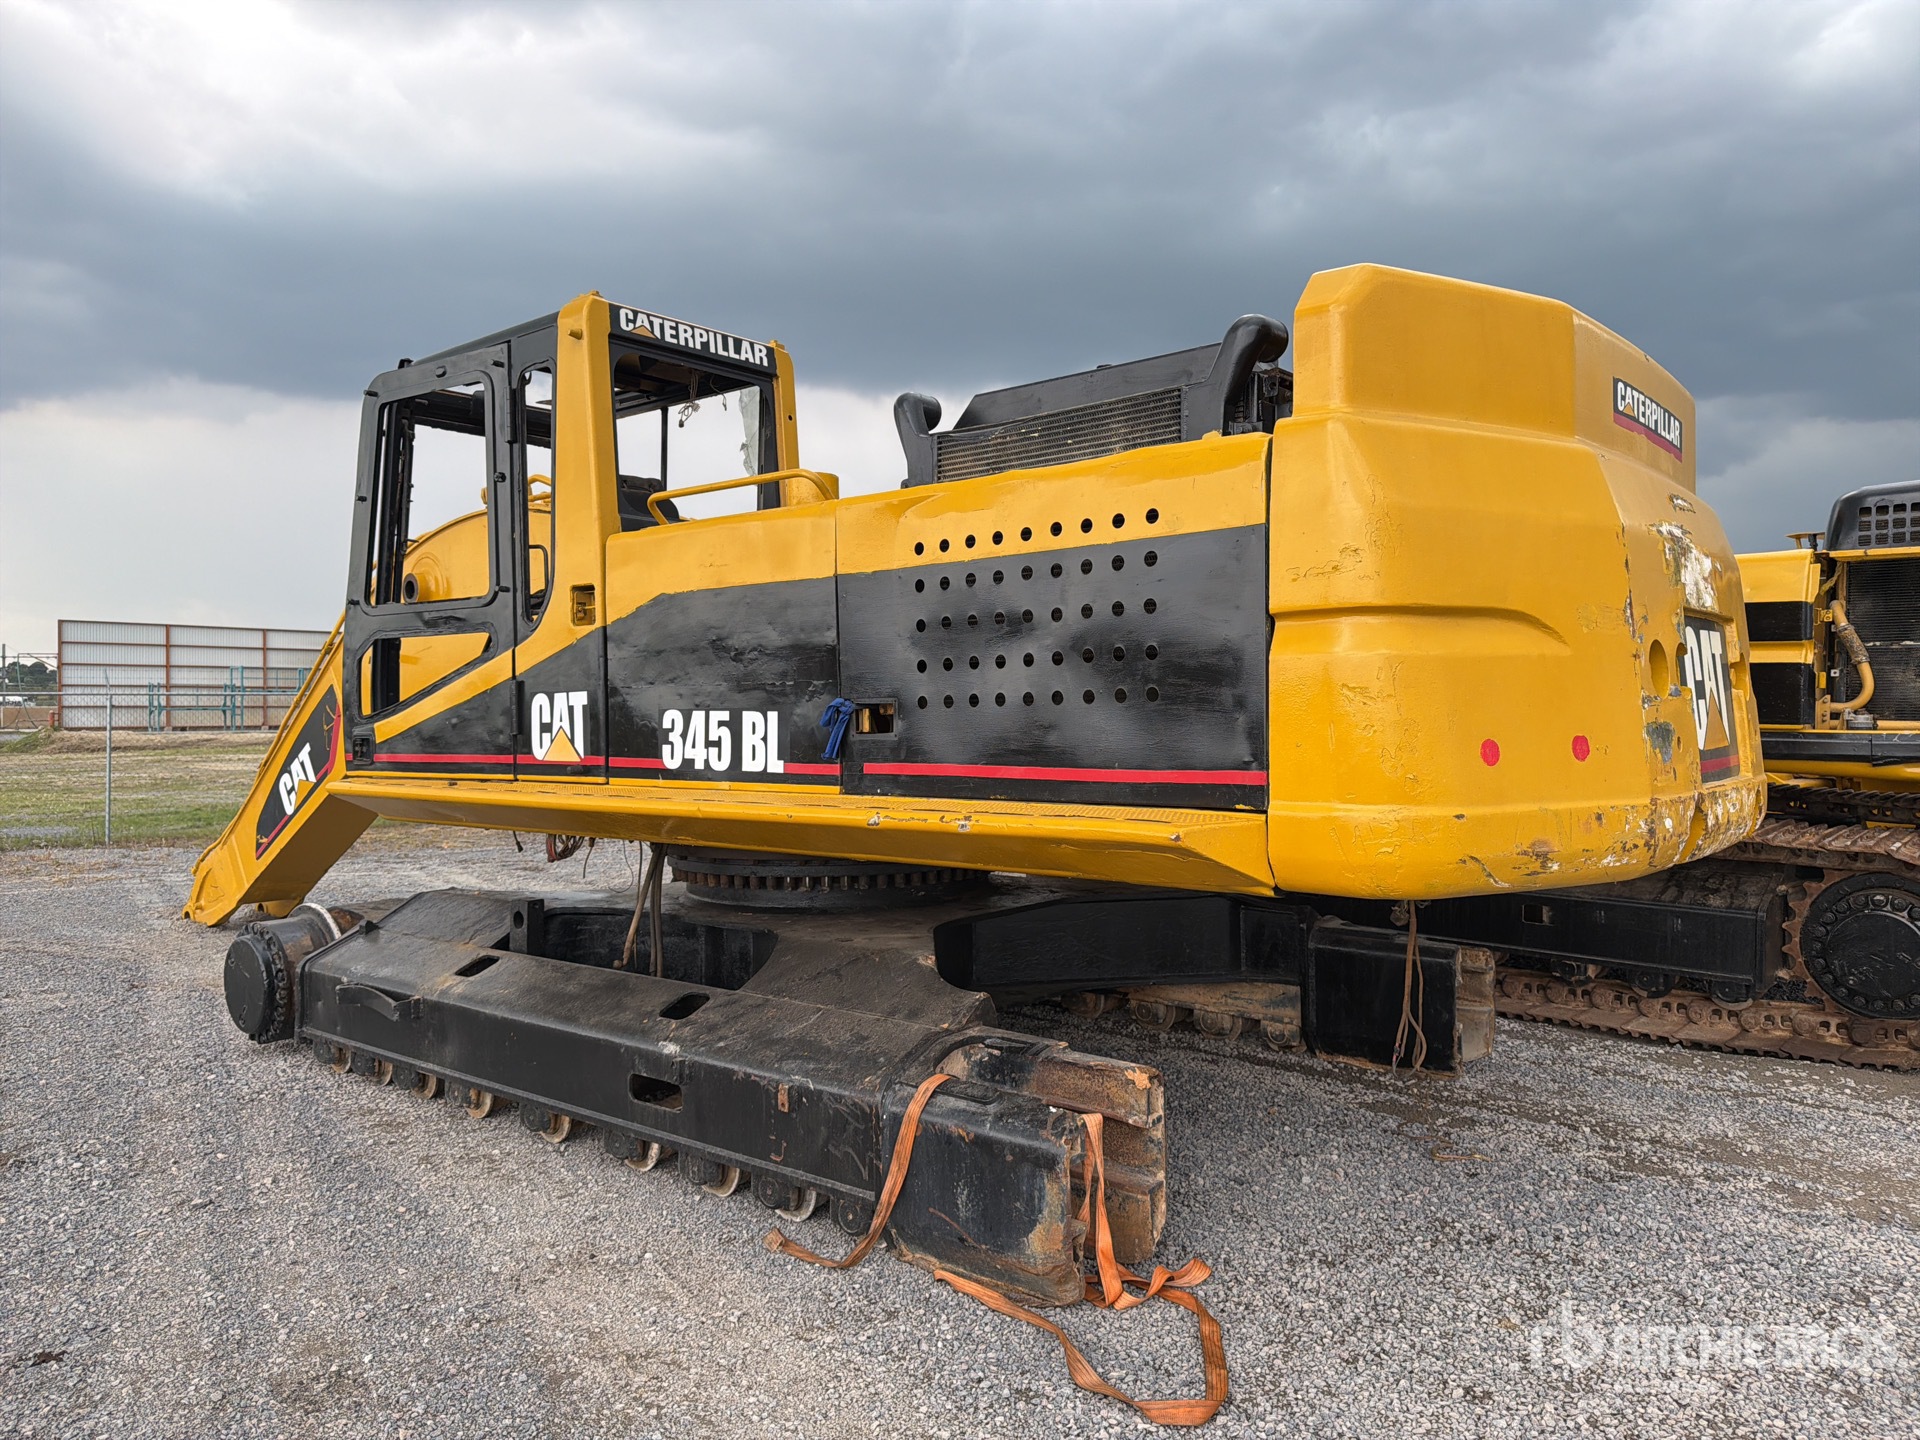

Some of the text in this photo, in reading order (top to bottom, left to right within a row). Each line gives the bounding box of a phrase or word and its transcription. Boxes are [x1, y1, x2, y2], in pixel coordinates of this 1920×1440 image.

[619, 307, 769, 367] CATERPILLAR
[1617, 381, 1680, 448] CATERPILLAR
[1684, 626, 1730, 750] CAT
[531, 690, 588, 761] CAT
[662, 709, 784, 773] 345 BL
[279, 742, 317, 815] CAT
